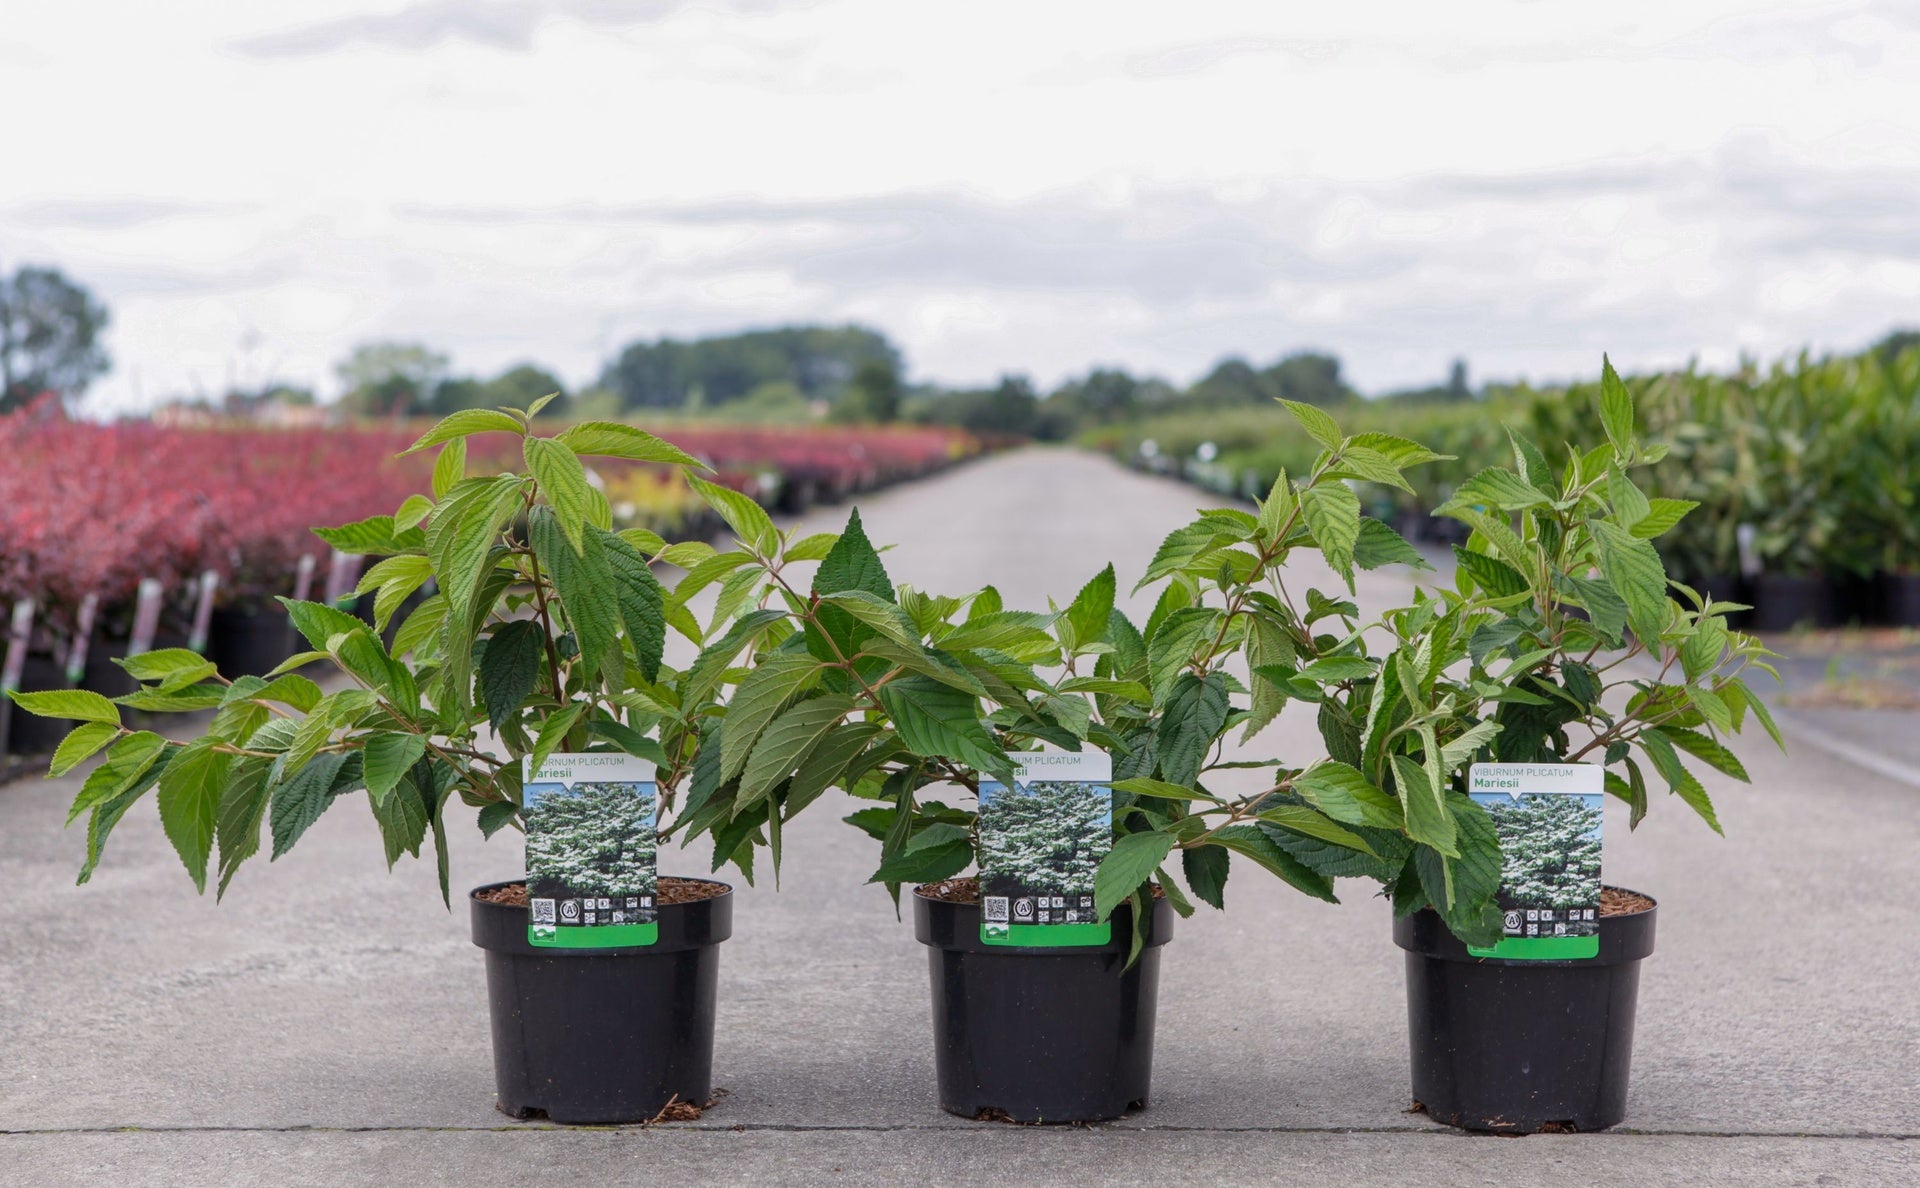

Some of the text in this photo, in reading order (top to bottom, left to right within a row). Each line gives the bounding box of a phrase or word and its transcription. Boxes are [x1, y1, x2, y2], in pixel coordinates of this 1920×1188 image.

[526, 757, 625, 767] VURNUM PLICATUM
[1034, 756, 1081, 765] PLICATUM
[1474, 768, 1574, 777] VIBURNUM PLICATUM
[1474, 778, 1519, 788] Mariesii
